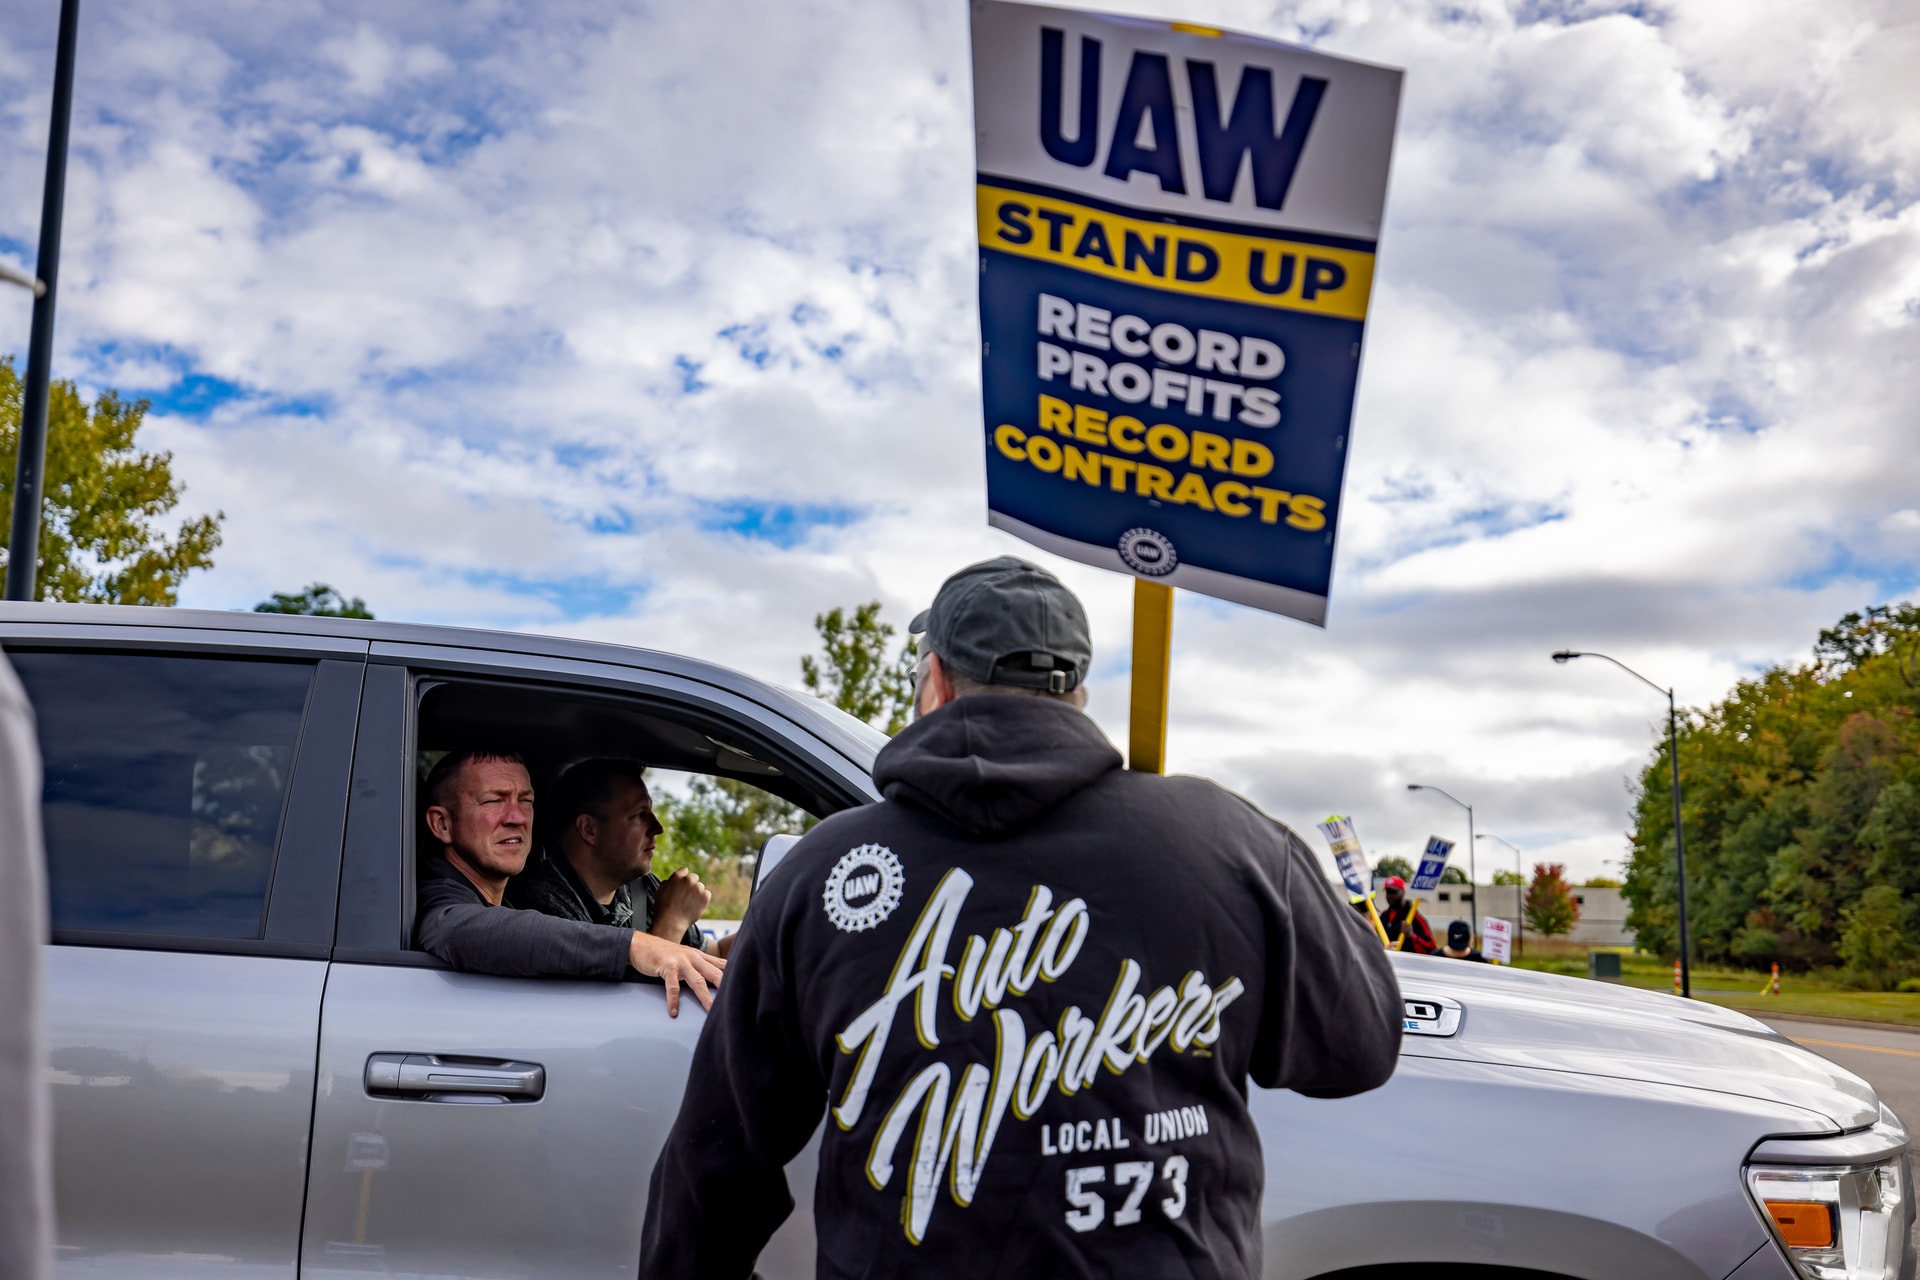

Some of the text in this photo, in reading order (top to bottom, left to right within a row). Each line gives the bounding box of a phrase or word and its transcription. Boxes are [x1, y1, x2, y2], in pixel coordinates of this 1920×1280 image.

[1040, 26, 1330, 211] UAW
[996, 201, 1347, 301] STAND UP
[1038, 292, 1286, 381] RECORD
[1037, 340, 1282, 429] PROFITS
[994, 424, 1327, 532] CONTRACTS
[1038, 393, 1275, 478] RECORD
[1136, 544, 1161, 559] UAW
[844, 872, 880, 901] UAW
[1427, 837, 1454, 858] UAW
[833, 866, 1090, 1131] Auto
[865, 958, 1245, 1246] Workers
[1041, 1105, 1210, 1155] LOCAL UNION
[1065, 1155, 1190, 1232] 573
